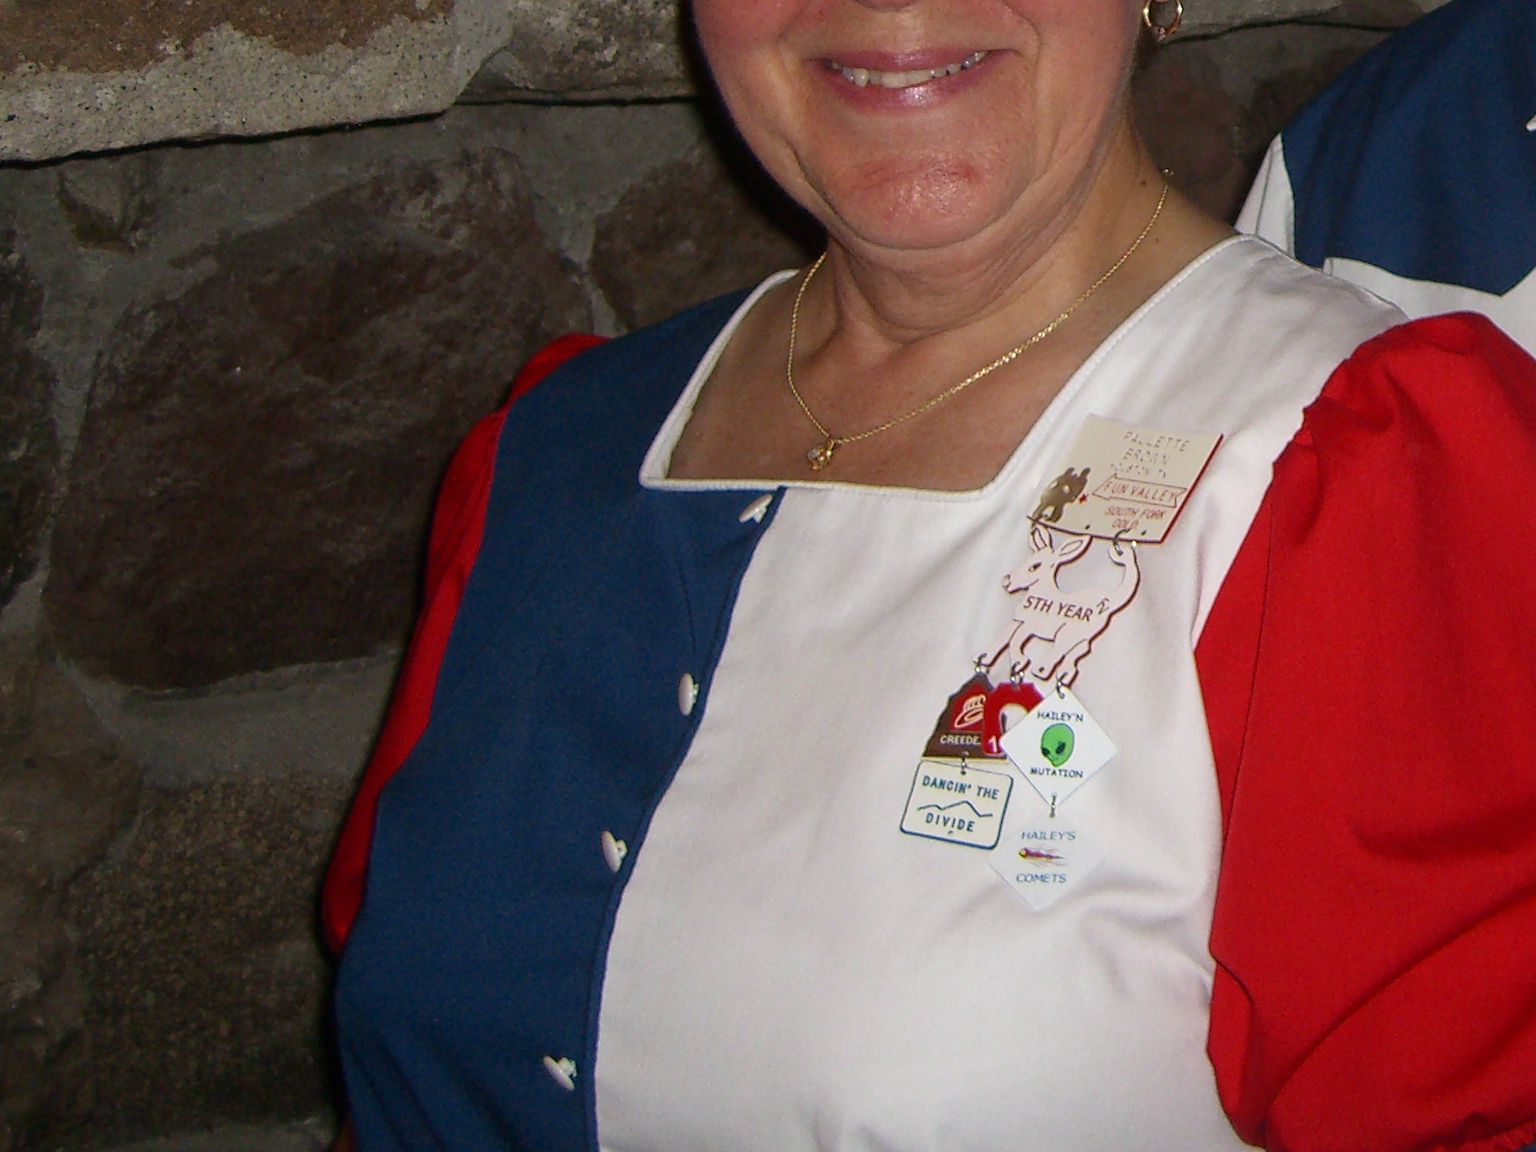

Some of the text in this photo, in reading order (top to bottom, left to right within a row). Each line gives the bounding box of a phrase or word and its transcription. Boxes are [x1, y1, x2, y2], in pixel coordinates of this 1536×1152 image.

[1123, 448, 1171, 466] BROWN
[1103, 481, 1178, 503] FUN VALLEY
[1105, 506, 1167, 521] SOUTH FORK
[1023, 595, 1094, 622] 5TH YEAR
[1037, 711, 1084, 723] HAILEY'N
[1030, 767, 1084, 778] MUTATION
[922, 775, 1000, 800] DANCIN' THE
[925, 812, 976, 833] DIVIDE
[1021, 830, 1077, 842] HAILEY'S
[1016, 872, 1067, 884] COMETS
